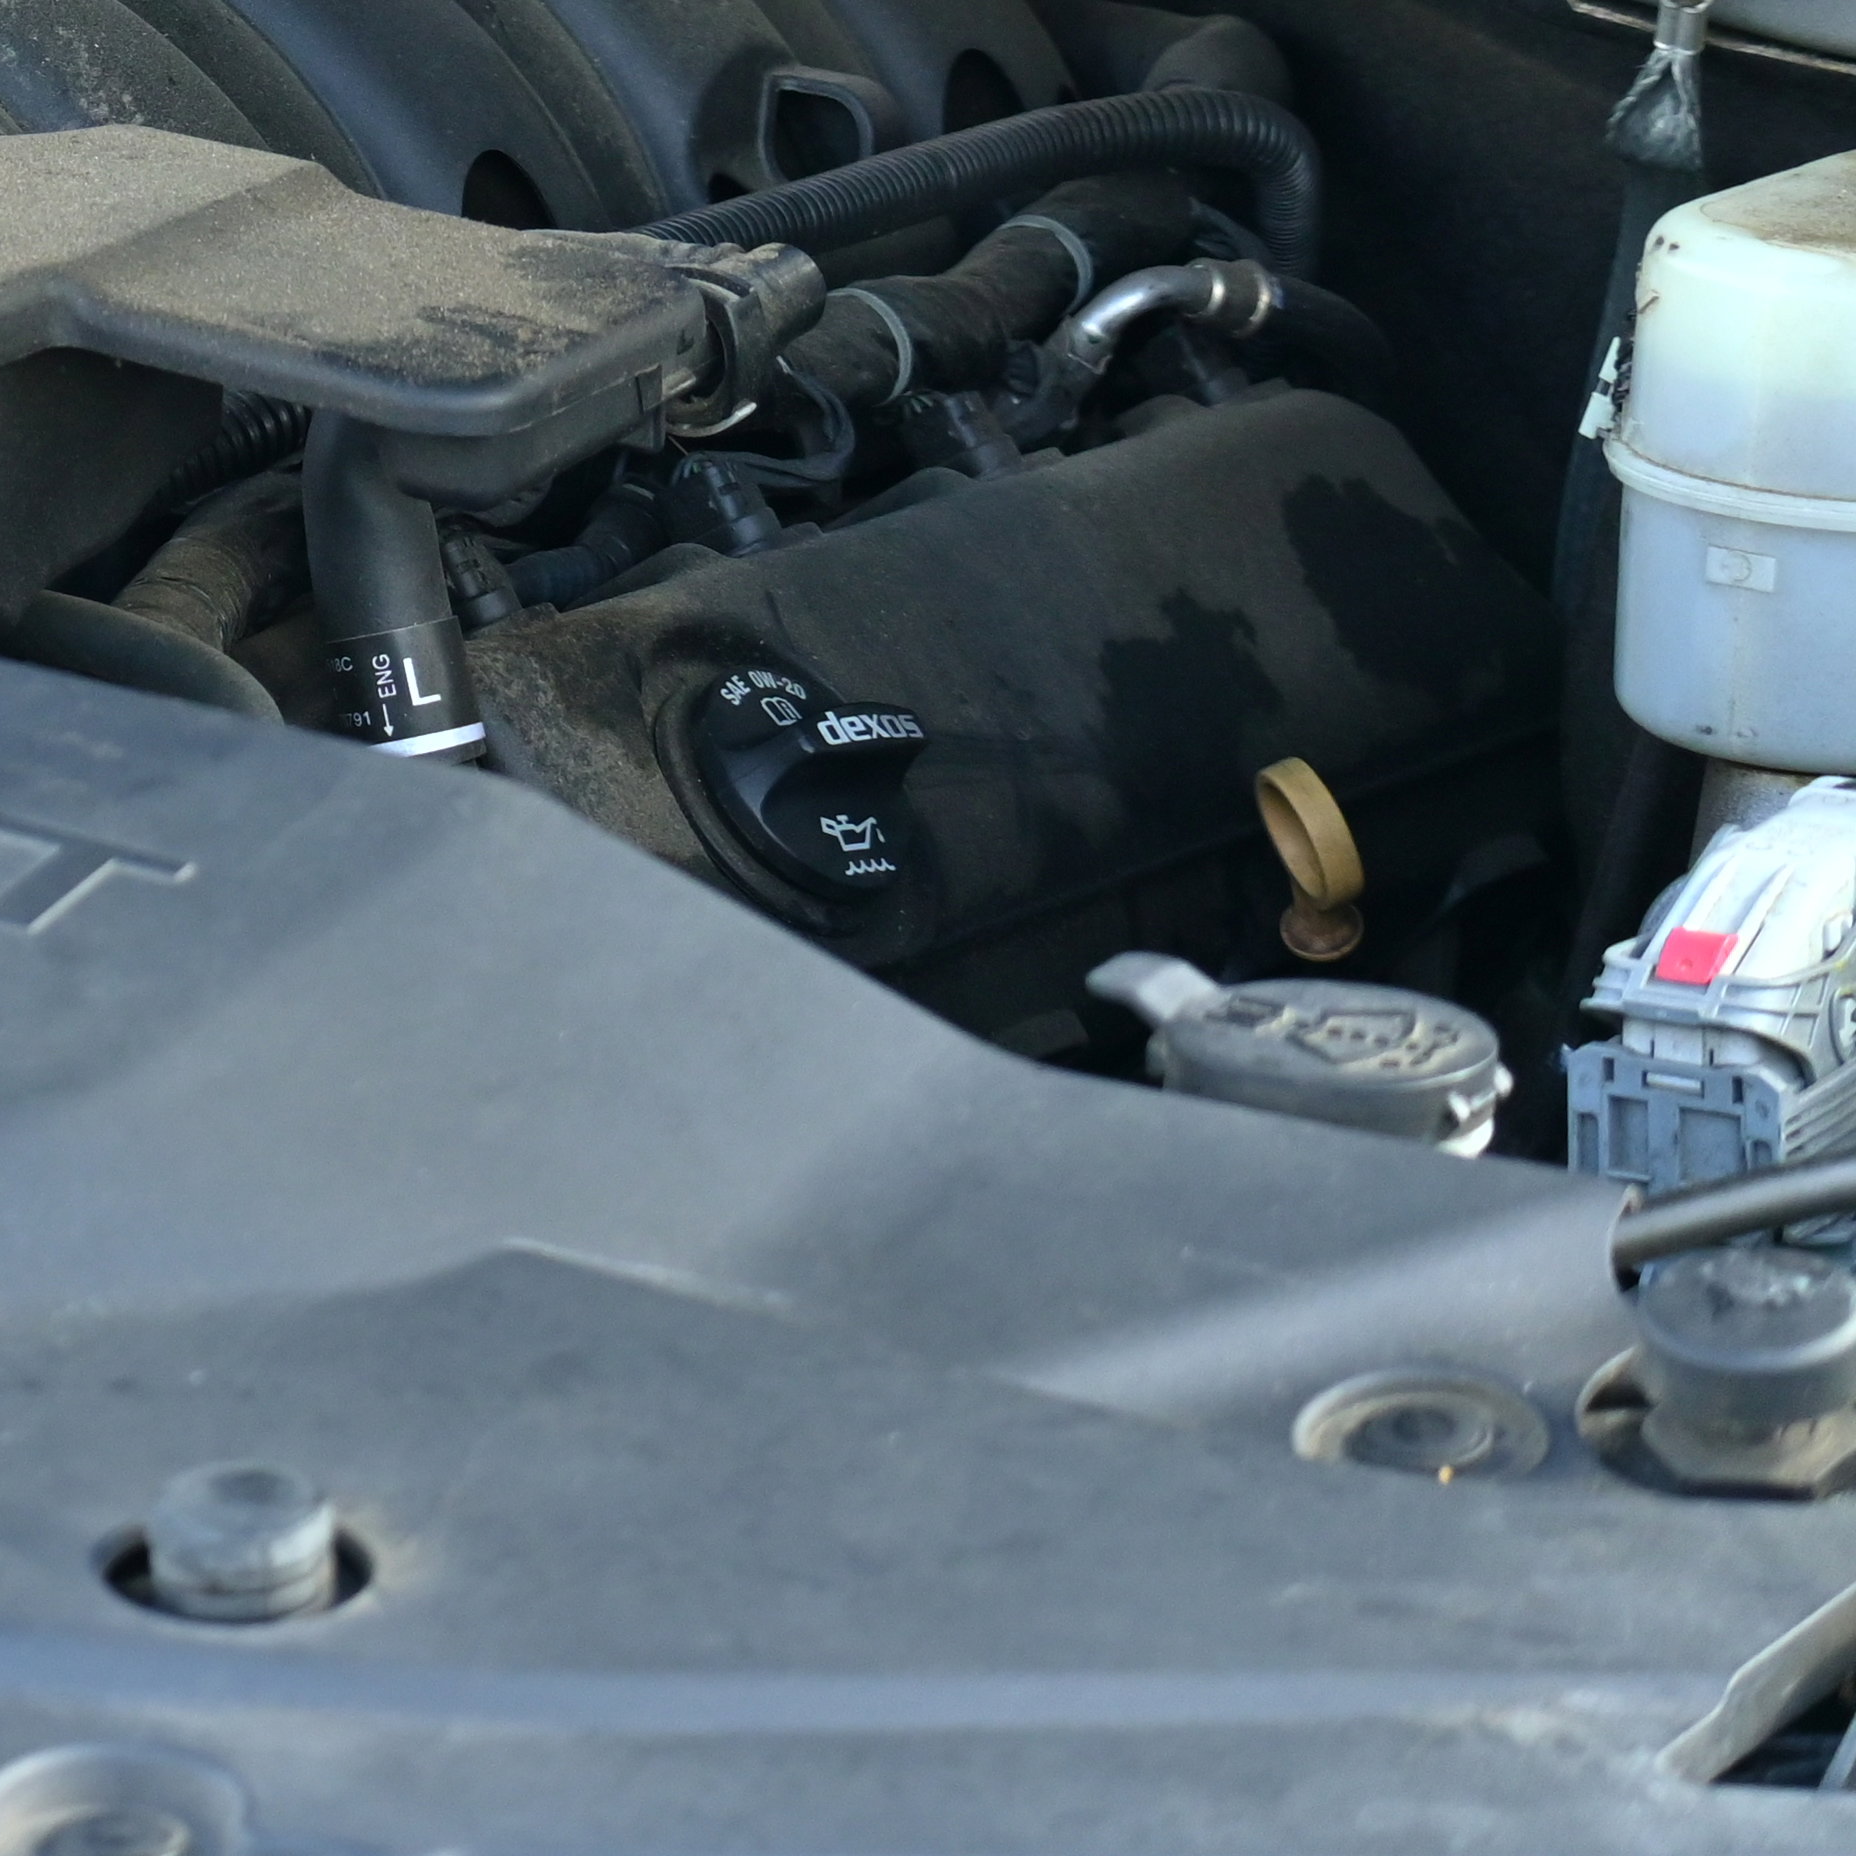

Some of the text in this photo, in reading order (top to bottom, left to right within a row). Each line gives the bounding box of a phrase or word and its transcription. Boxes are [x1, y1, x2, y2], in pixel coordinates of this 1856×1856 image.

[372, 652, 397, 699] ENG
[402, 656, 442, 707] L
[720, 674, 751, 706] SAE
[748, 669, 807, 700] 0W-20
[815, 710, 925, 746] dexos
